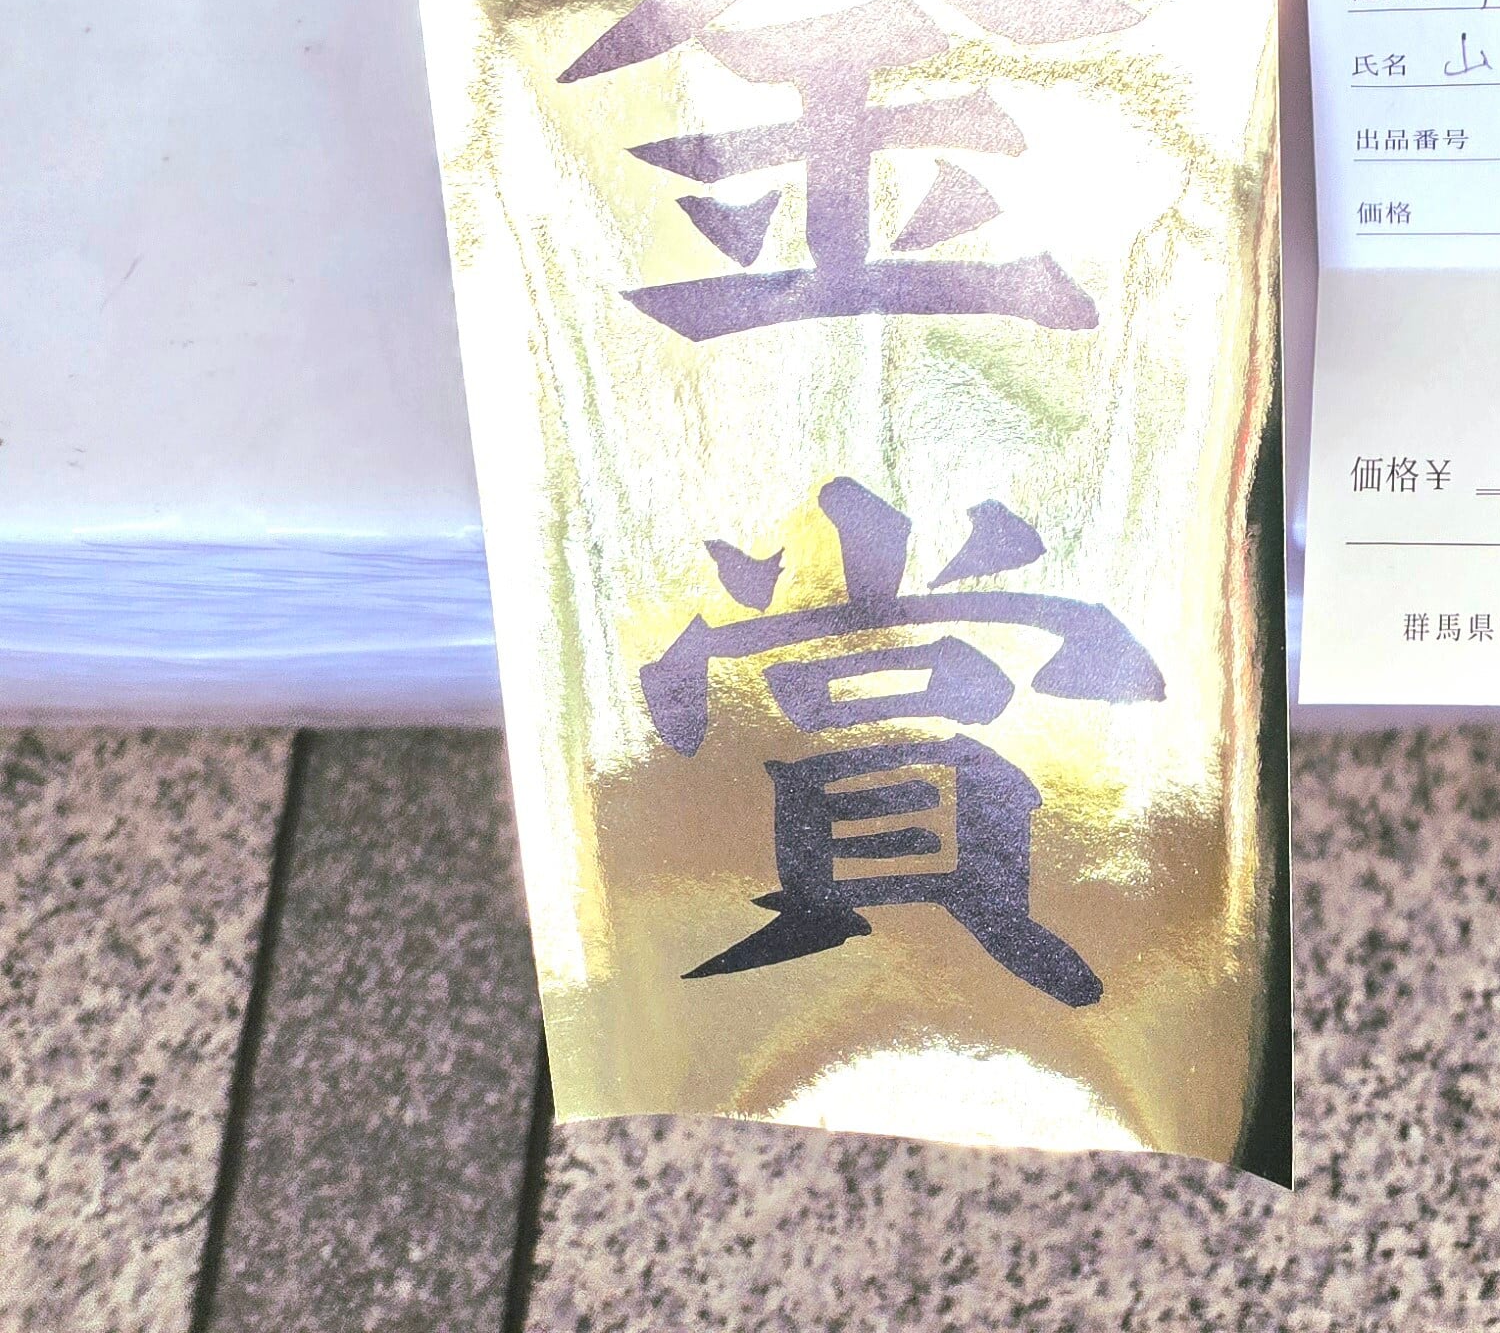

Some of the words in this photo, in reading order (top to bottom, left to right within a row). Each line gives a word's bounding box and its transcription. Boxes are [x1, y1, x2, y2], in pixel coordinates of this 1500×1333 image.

[1351, 53, 1408, 78] 氏名
[1355, 127, 1470, 152] 出品番号
[1356, 201, 1413, 226] 価格
